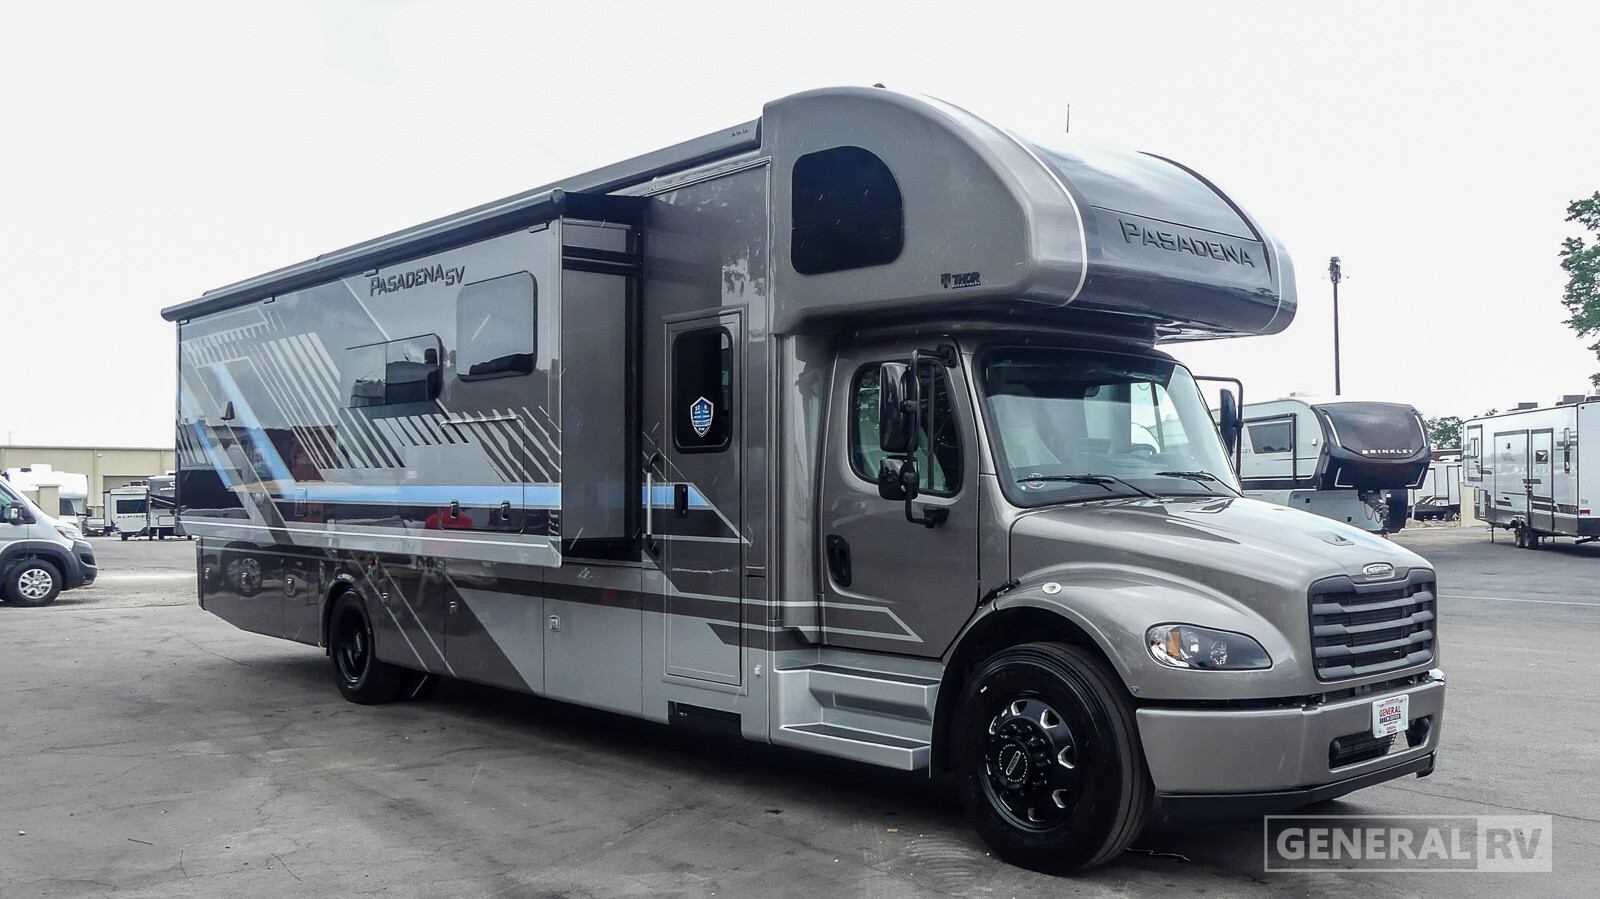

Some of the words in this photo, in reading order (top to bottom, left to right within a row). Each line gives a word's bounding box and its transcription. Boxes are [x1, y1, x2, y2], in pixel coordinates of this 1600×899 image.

[1118, 218, 1256, 268] PASADENA
[370, 263, 445, 297] PASADENA
[445, 265, 466, 287] SV
[951, 271, 981, 286] THOR
[1379, 705, 1401, 717] GENERAL
